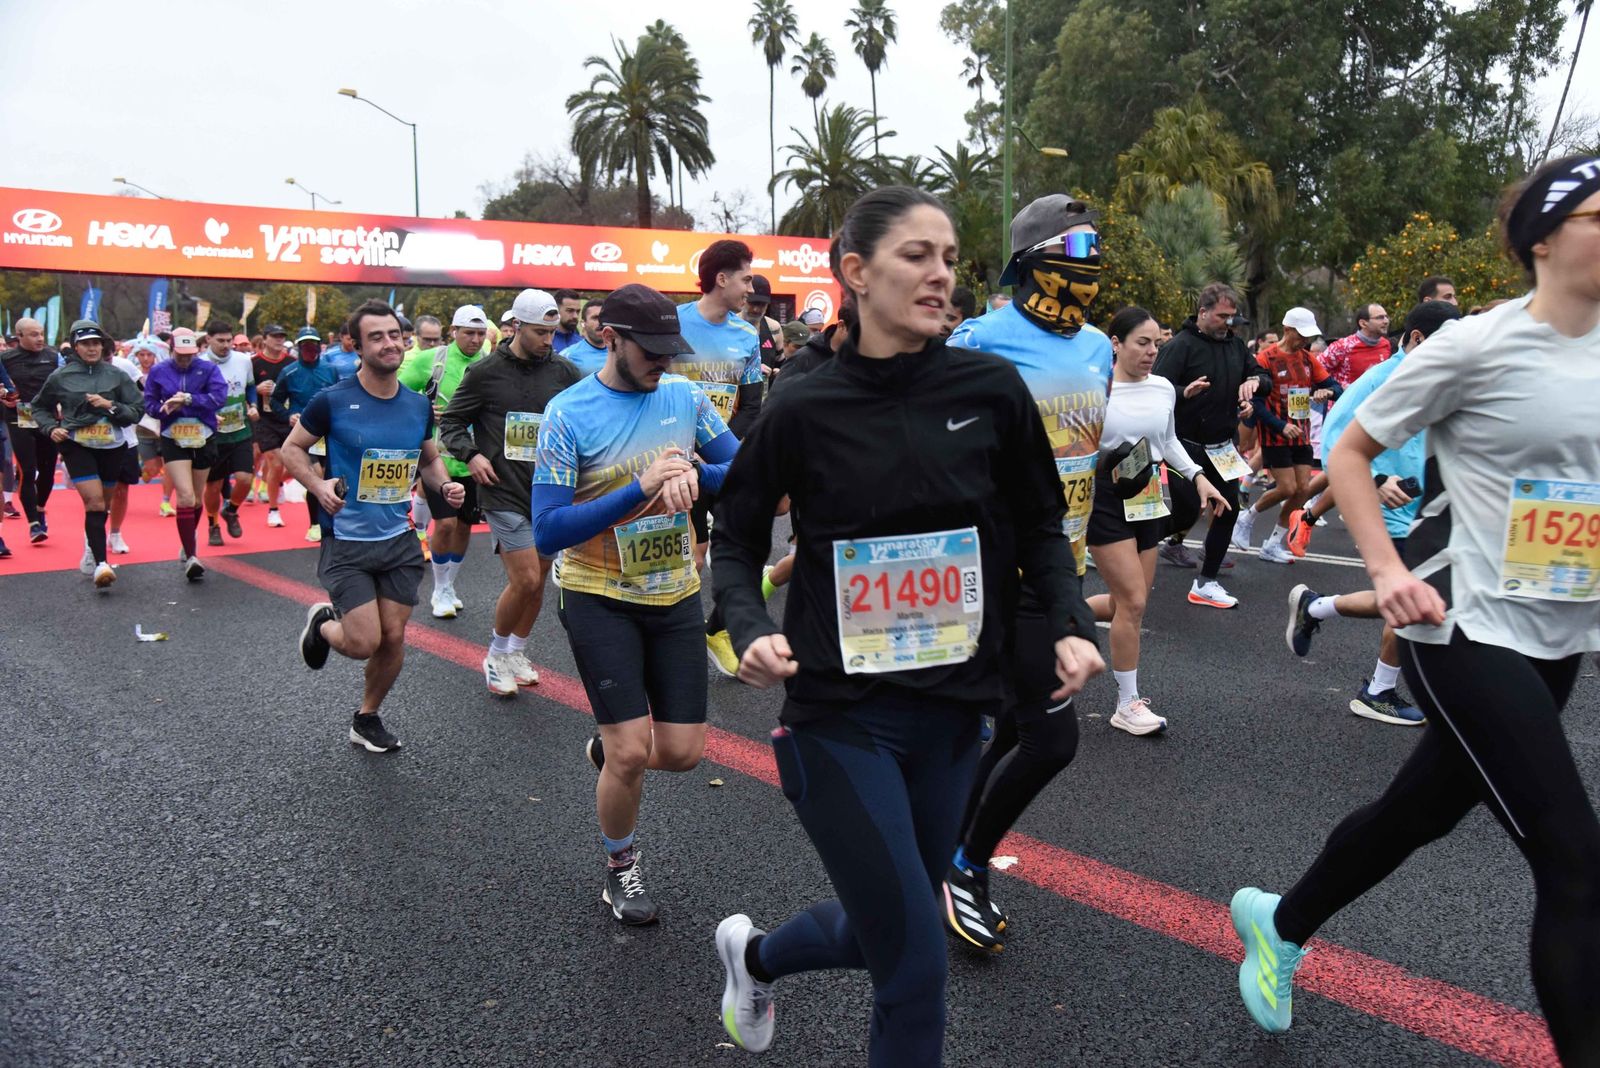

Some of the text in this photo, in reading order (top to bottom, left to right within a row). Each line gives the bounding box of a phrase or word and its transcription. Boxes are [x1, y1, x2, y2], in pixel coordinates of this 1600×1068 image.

[3, 232, 73, 247] HYUNDAI
[87, 220, 177, 249] HOKA
[292, 226, 399, 249] maratón
[320, 245, 403, 267] sevilla
[512, 243, 575, 266] HOKA
[709, 394, 729, 410] 547
[366, 463, 409, 479] 15501
[627, 533, 682, 563] 12565
[850, 565, 961, 613] 21490
